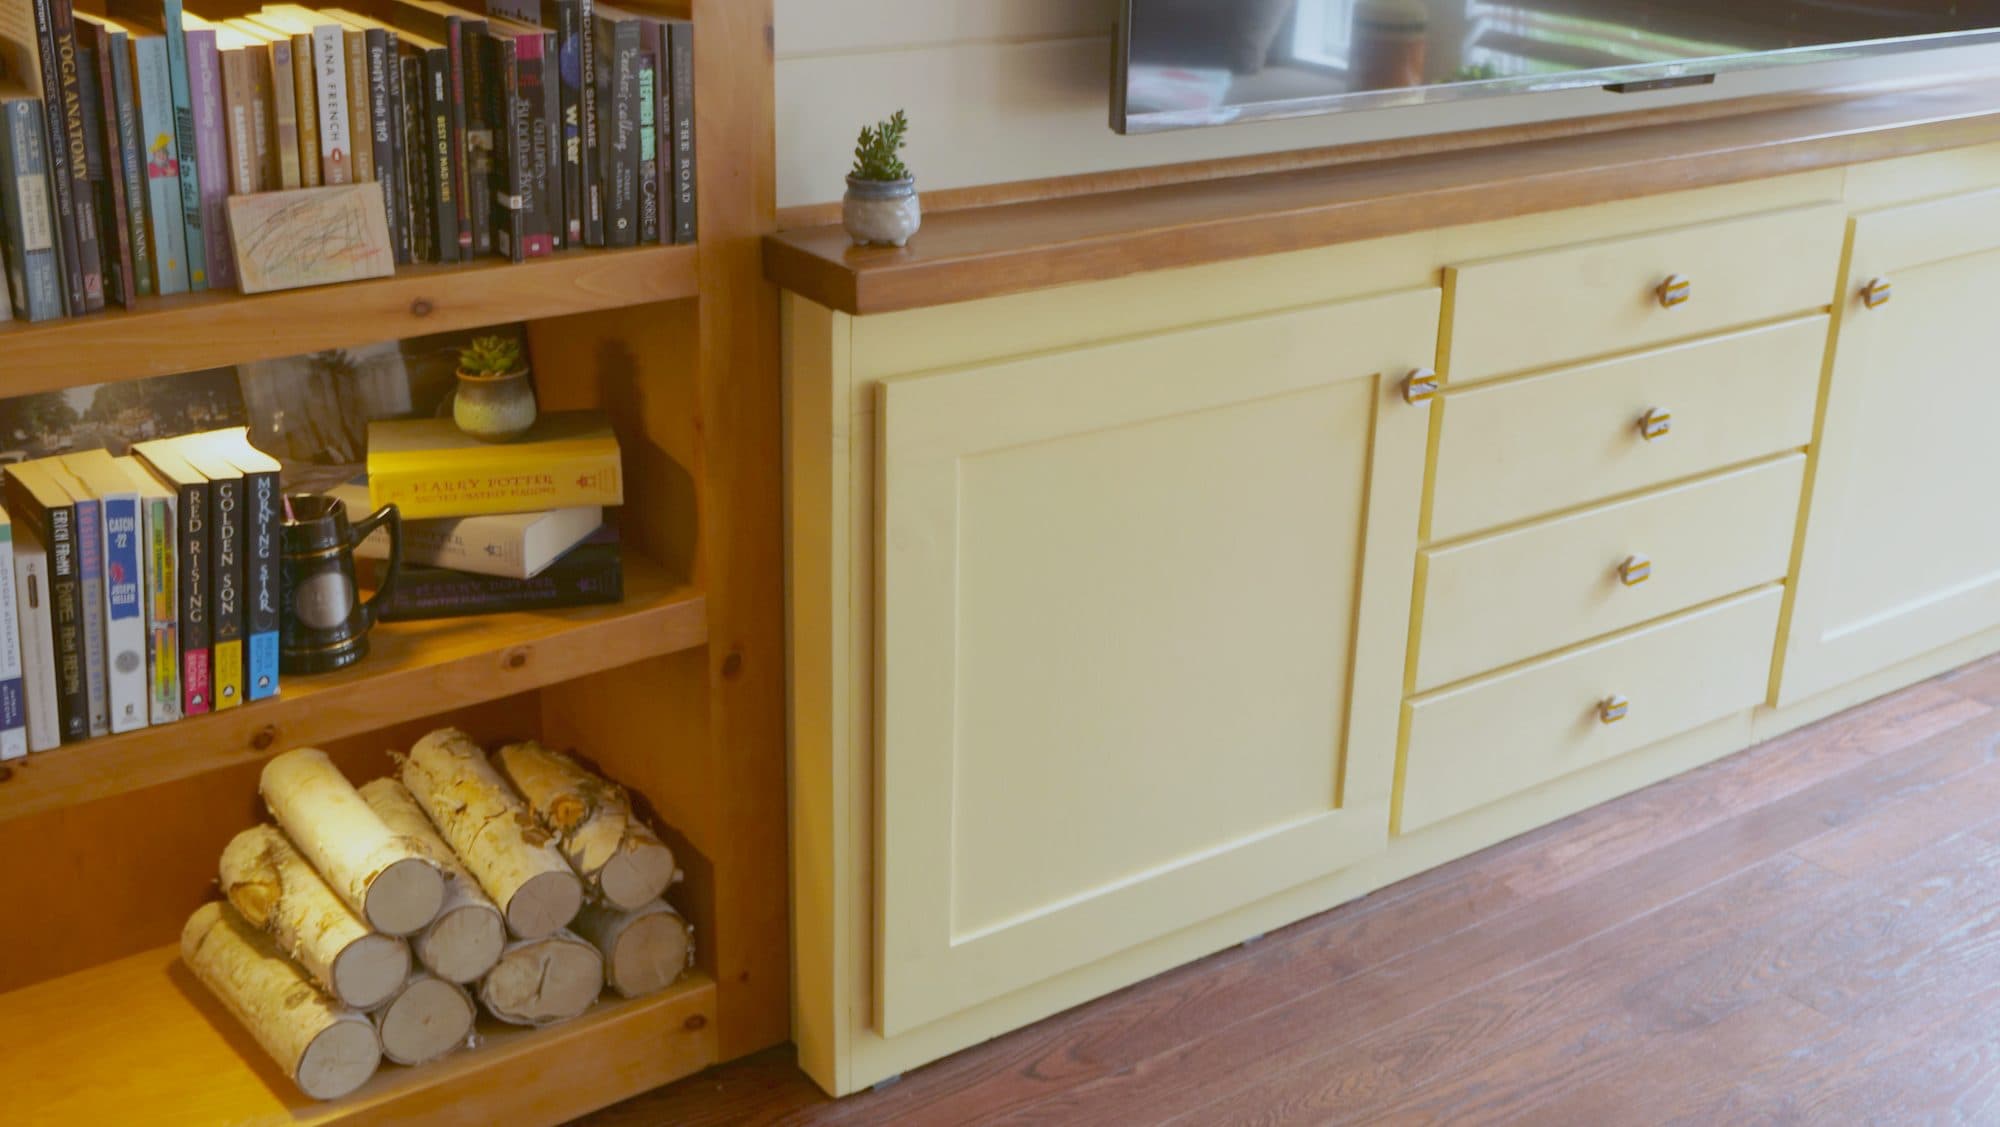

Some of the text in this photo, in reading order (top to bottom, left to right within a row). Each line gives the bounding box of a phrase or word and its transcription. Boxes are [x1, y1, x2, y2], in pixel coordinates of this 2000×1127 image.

[58, 35, 77, 86] YOGA
[323, 34, 336, 76] TANA
[583, 0, 597, 148] ENDURING SHAME
[64, 91, 87, 182] ANATOMY
[176, 105, 195, 163] RUNNING
[328, 83, 341, 142] FRENCH
[613, 102, 633, 152] calling
[437, 115, 450, 203] BEST OF MAD LIBS
[680, 118, 691, 204] THE ROAD
[125, 136, 138, 180] SEARCH
[134, 210, 147, 261] MEANING
[643, 179, 657, 225] CARRIE
[411, 475, 553, 492] HARRY POTTER
[53, 510, 68, 541] ERICH
[109, 516, 135, 531] CATCH
[220, 483, 235, 615] GOLDEN SON
[258, 476, 275, 614] MORNING STAR
[189, 491, 203, 623] RED RISING
[111, 584, 136, 595] JOSEPH
[112, 593, 136, 604] HELLER
[188, 654, 198, 691] BROWN
[198, 654, 207, 688] PIERCE
